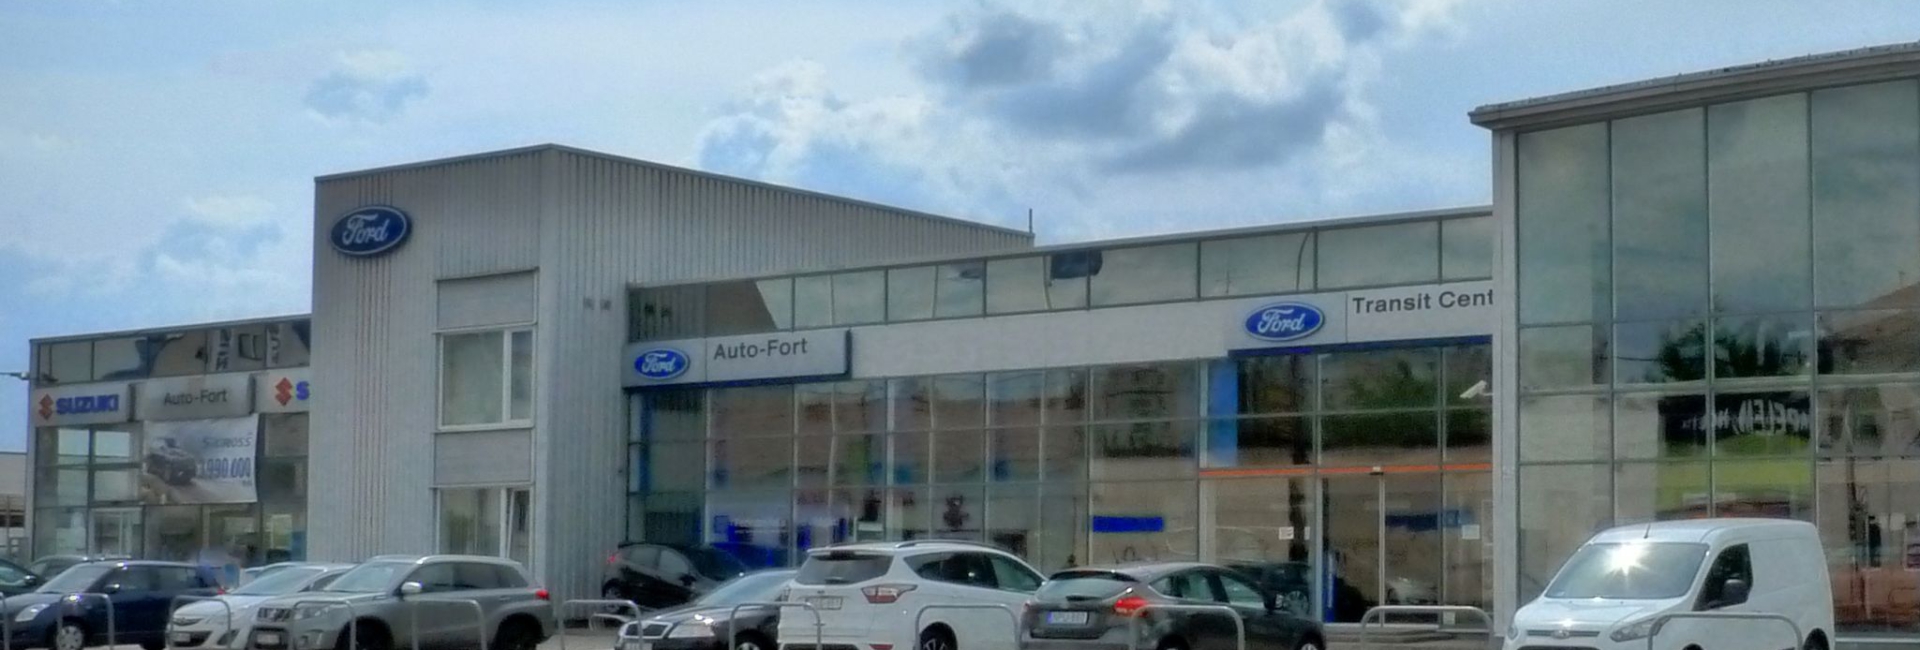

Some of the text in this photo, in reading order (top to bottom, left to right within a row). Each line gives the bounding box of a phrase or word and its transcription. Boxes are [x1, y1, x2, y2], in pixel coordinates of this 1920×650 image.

[342, 213, 390, 246] Ford
[1352, 293, 1431, 314] Transit
[1257, 308, 1307, 334] Ford
[714, 337, 808, 361] Auto-Fort
[56, 394, 119, 415] SUZUKI
[163, 388, 228, 406] Auto-Fort
